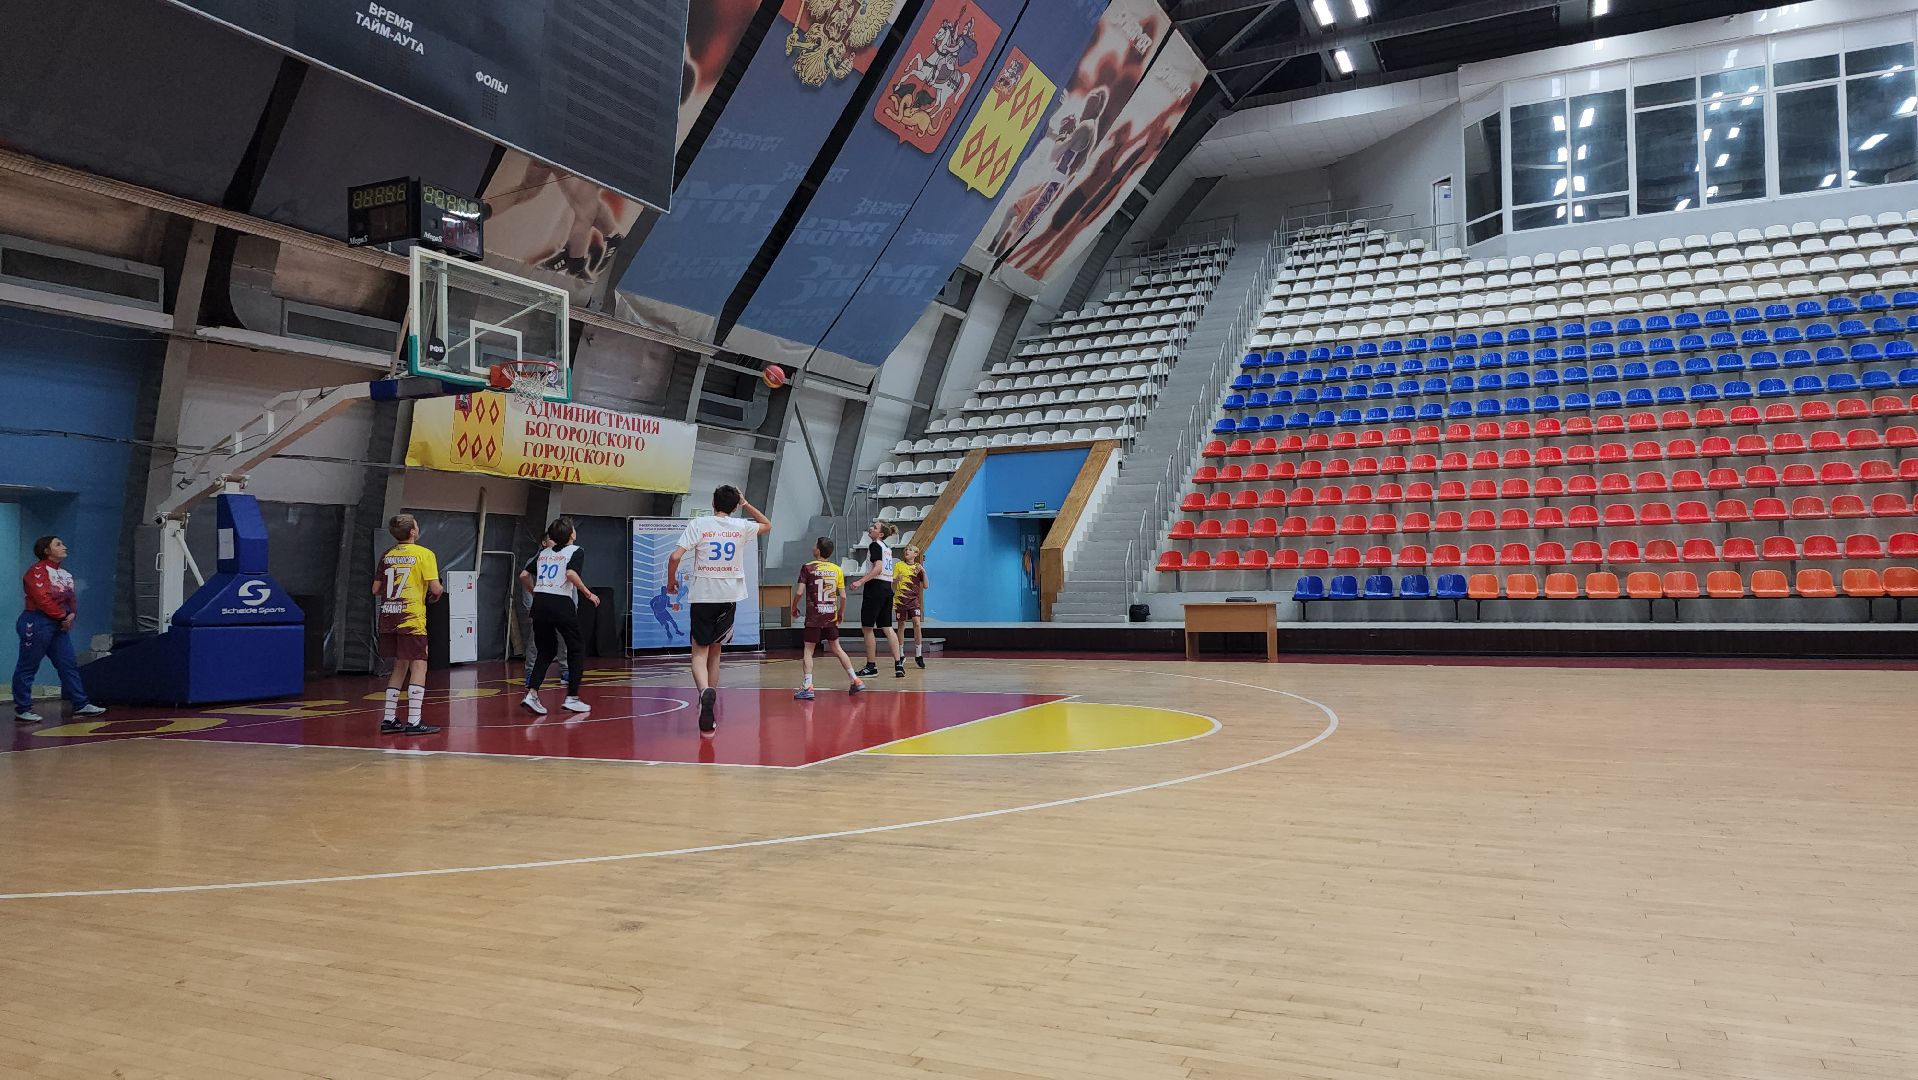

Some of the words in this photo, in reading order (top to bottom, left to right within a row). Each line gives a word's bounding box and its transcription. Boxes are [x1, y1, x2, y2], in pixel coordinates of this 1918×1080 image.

[368, 1, 414, 33] ВРЕМЯ
[355, 11, 425, 55] ТАЙМ-АУТА
[475, 70, 509, 94] ФОЛЫ
[525, 400, 661, 435] АДМИНИСТРАЦИЯ
[525, 420, 646, 452] БОГОРОДСКОГО
[523, 441, 626, 468] ГОРОДСКОГО
[517, 462, 582, 482] ОКРУГА
[708, 541, 736, 561] 39
[384, 567, 411, 599] 17
[538, 563, 559, 579] 20
[814, 578, 837, 602] 12
[258, 606, 286, 614] Sports
